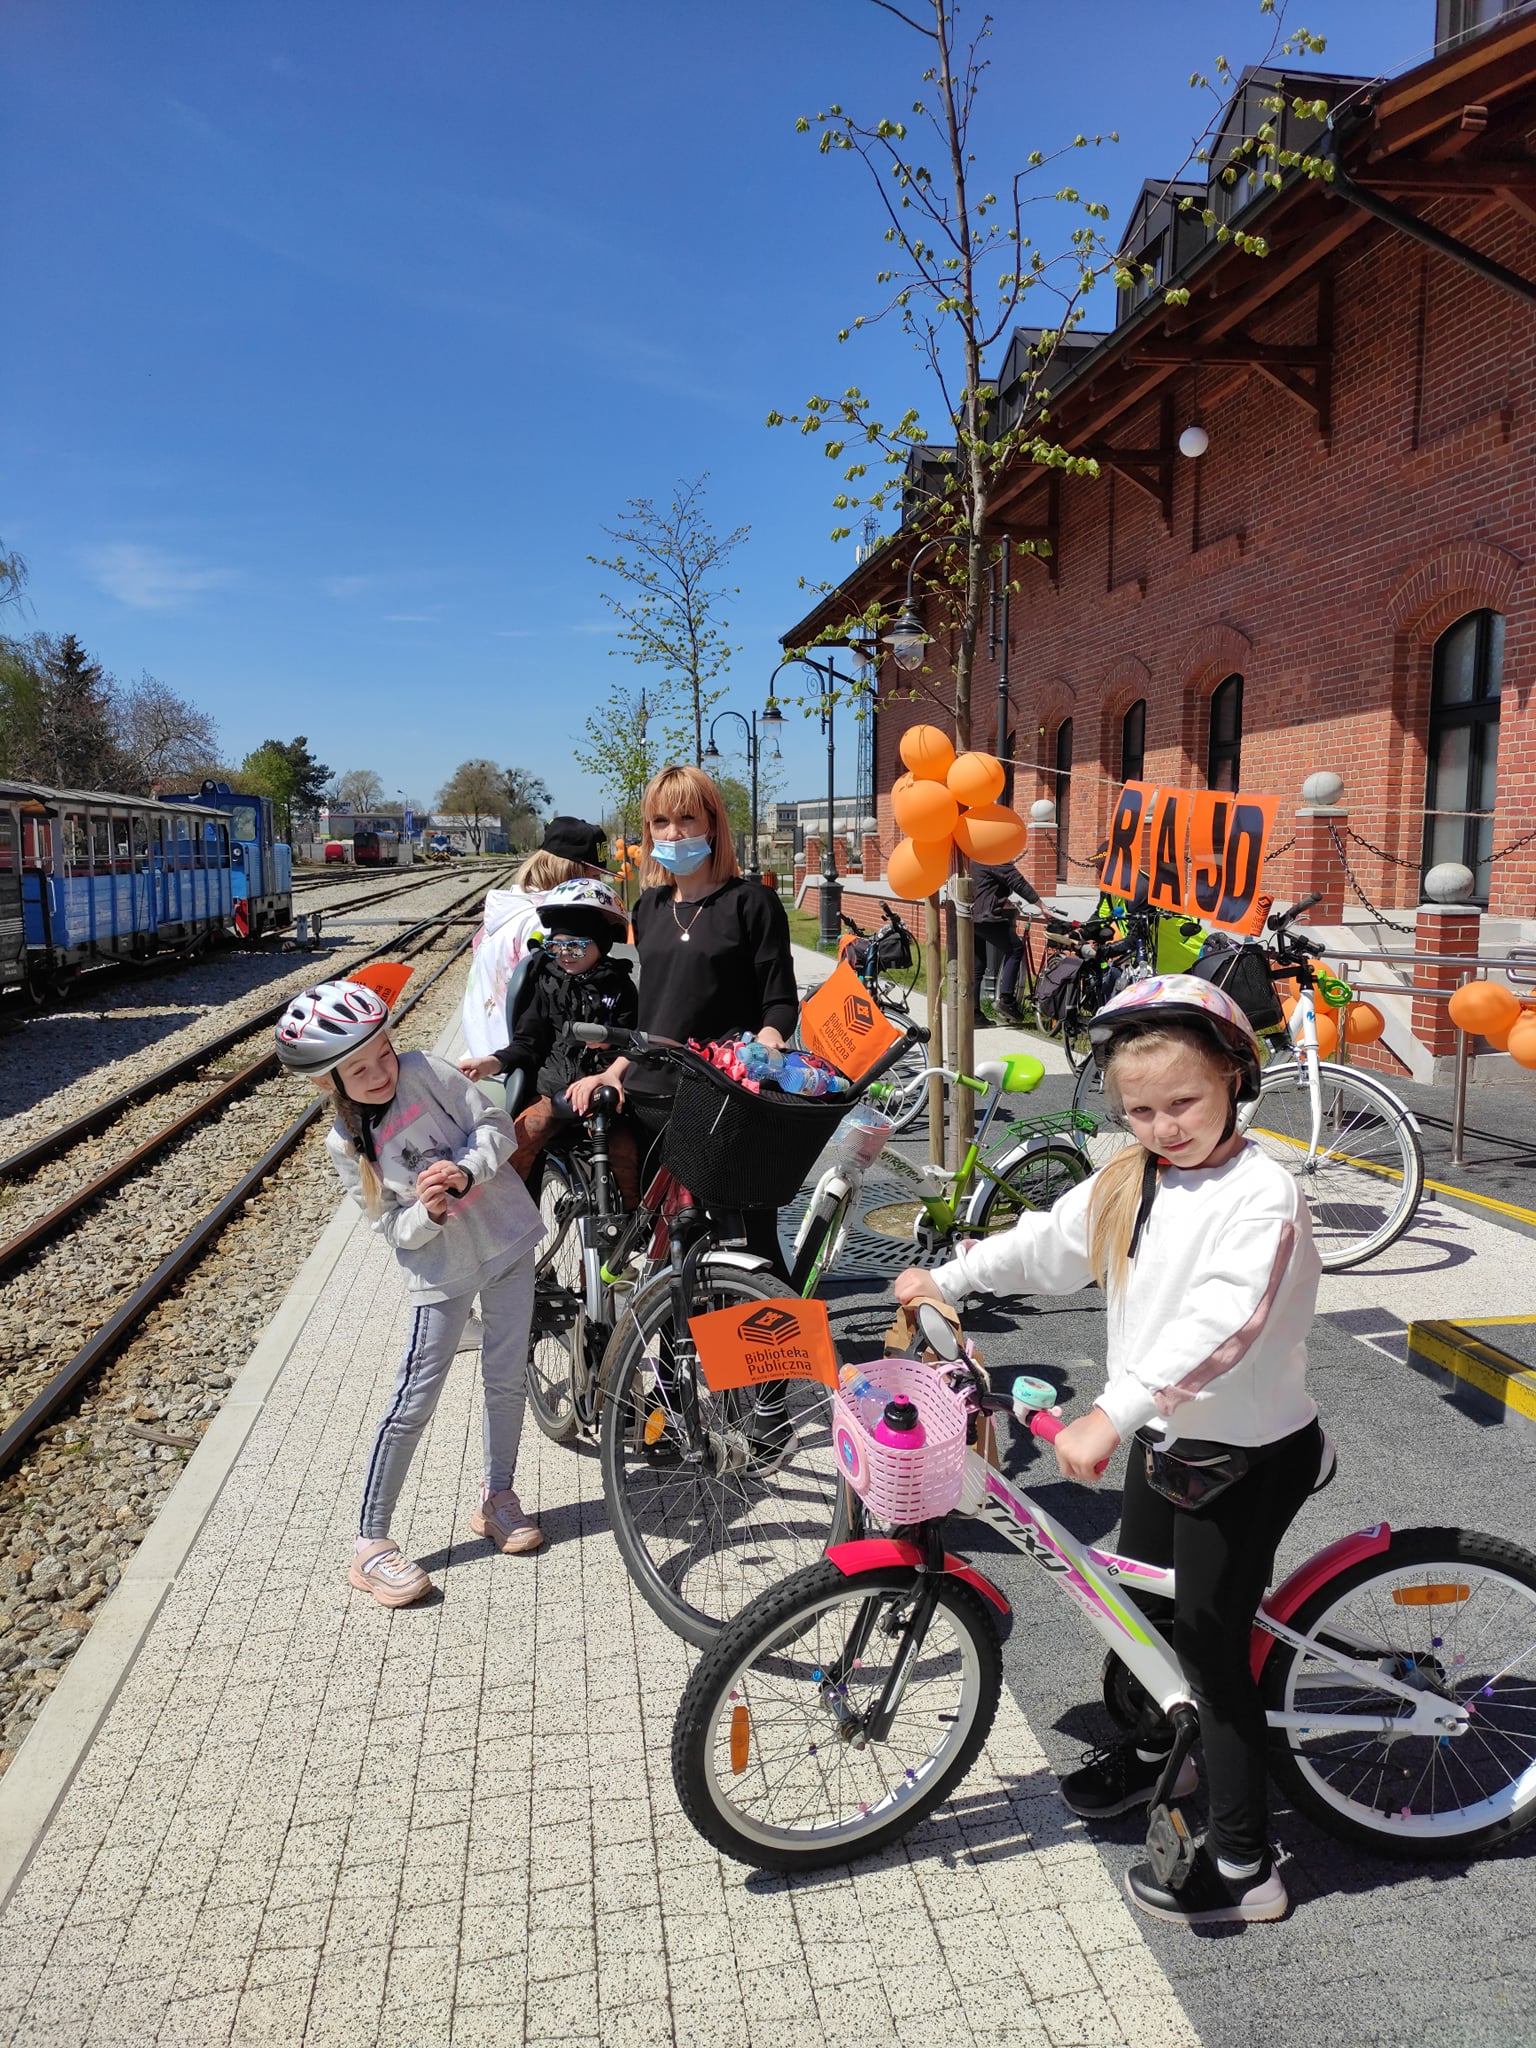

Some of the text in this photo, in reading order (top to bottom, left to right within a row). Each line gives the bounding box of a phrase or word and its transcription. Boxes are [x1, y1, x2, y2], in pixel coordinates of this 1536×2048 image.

[1103, 789, 1264, 923] RAJD
[822, 1020, 850, 1060] Publiczna
[829, 1012, 857, 1053] Biblioteka
[744, 1347, 809, 1365] Biblioteka
[747, 1358, 812, 1376] Publiczna
